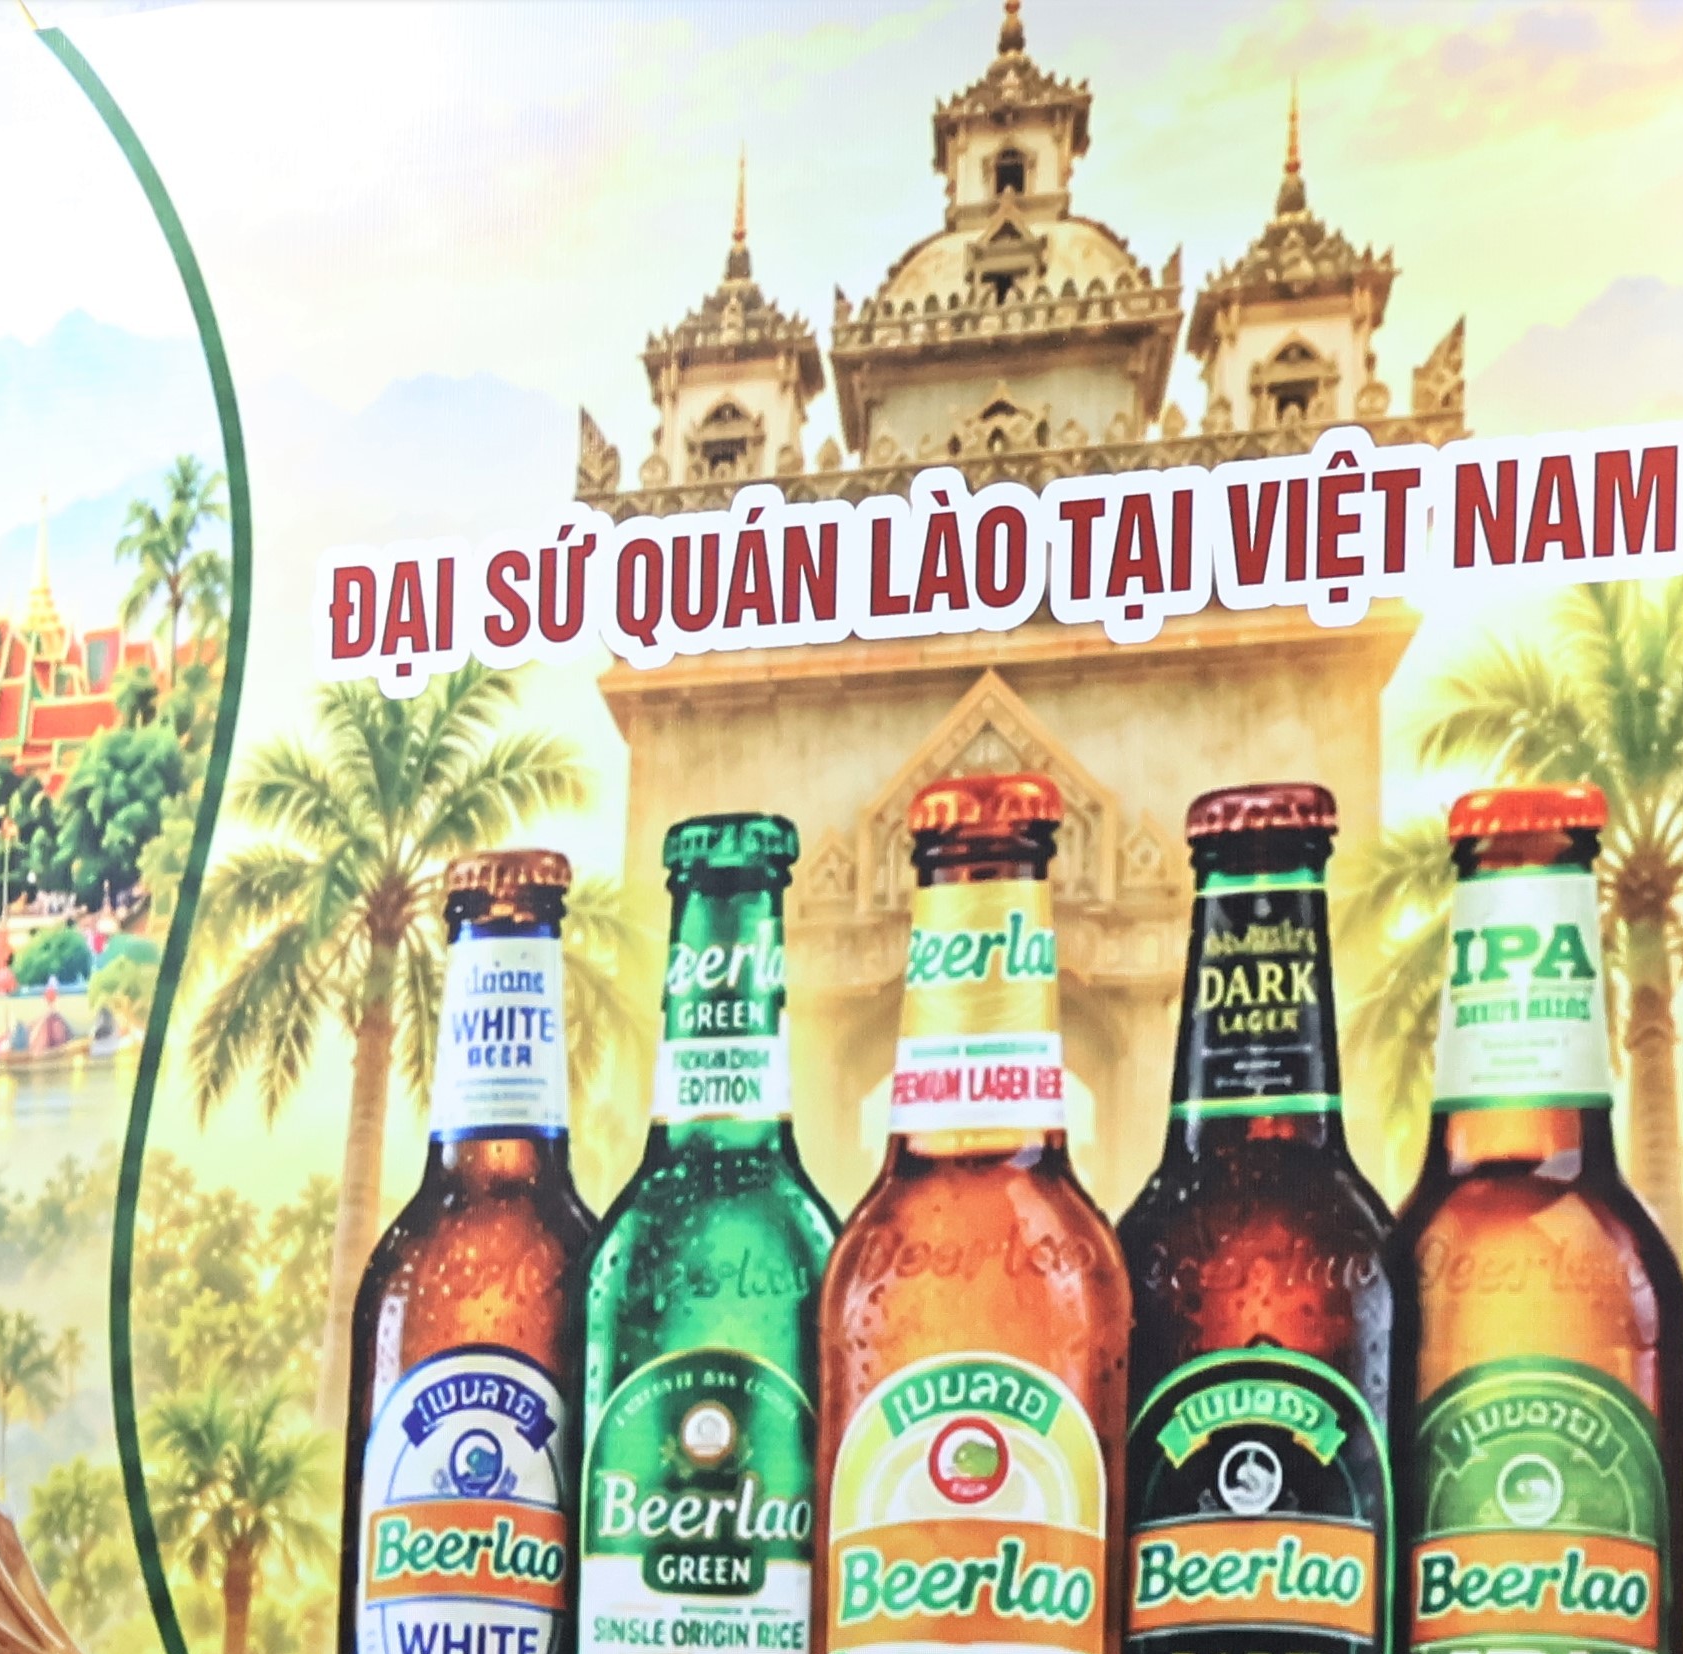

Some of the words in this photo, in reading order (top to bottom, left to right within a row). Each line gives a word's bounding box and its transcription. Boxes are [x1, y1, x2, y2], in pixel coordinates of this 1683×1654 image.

[328, 556, 456, 680] ĐẠI
[484, 522, 597, 648] SỨ
[627, 496, 838, 637] QUÁN
[870, 494, 1013, 617] LÀO
[1058, 485, 1195, 622] TẠI
[1225, 446, 1423, 605] VIỆT
[1450, 443, 1679, 572] NAM
[1197, 958, 1317, 1014] DARK
[1449, 923, 1598, 988] IPA
[450, 1005, 557, 1047] WHITE
[676, 1000, 768, 1032] GREEN
[597, 1472, 812, 1543] Beerlao
[374, 1514, 566, 1585] Beerlao
[657, 1552, 752, 1586] GREEN
[837, 1536, 1095, 1625] Beerlao
[1135, 1534, 1364, 1608] Beerlao
[1417, 1548, 1650, 1619] Beerlao
[672, 1619, 751, 1649] ORIGIN
[756, 1619, 806, 1650] RICE
